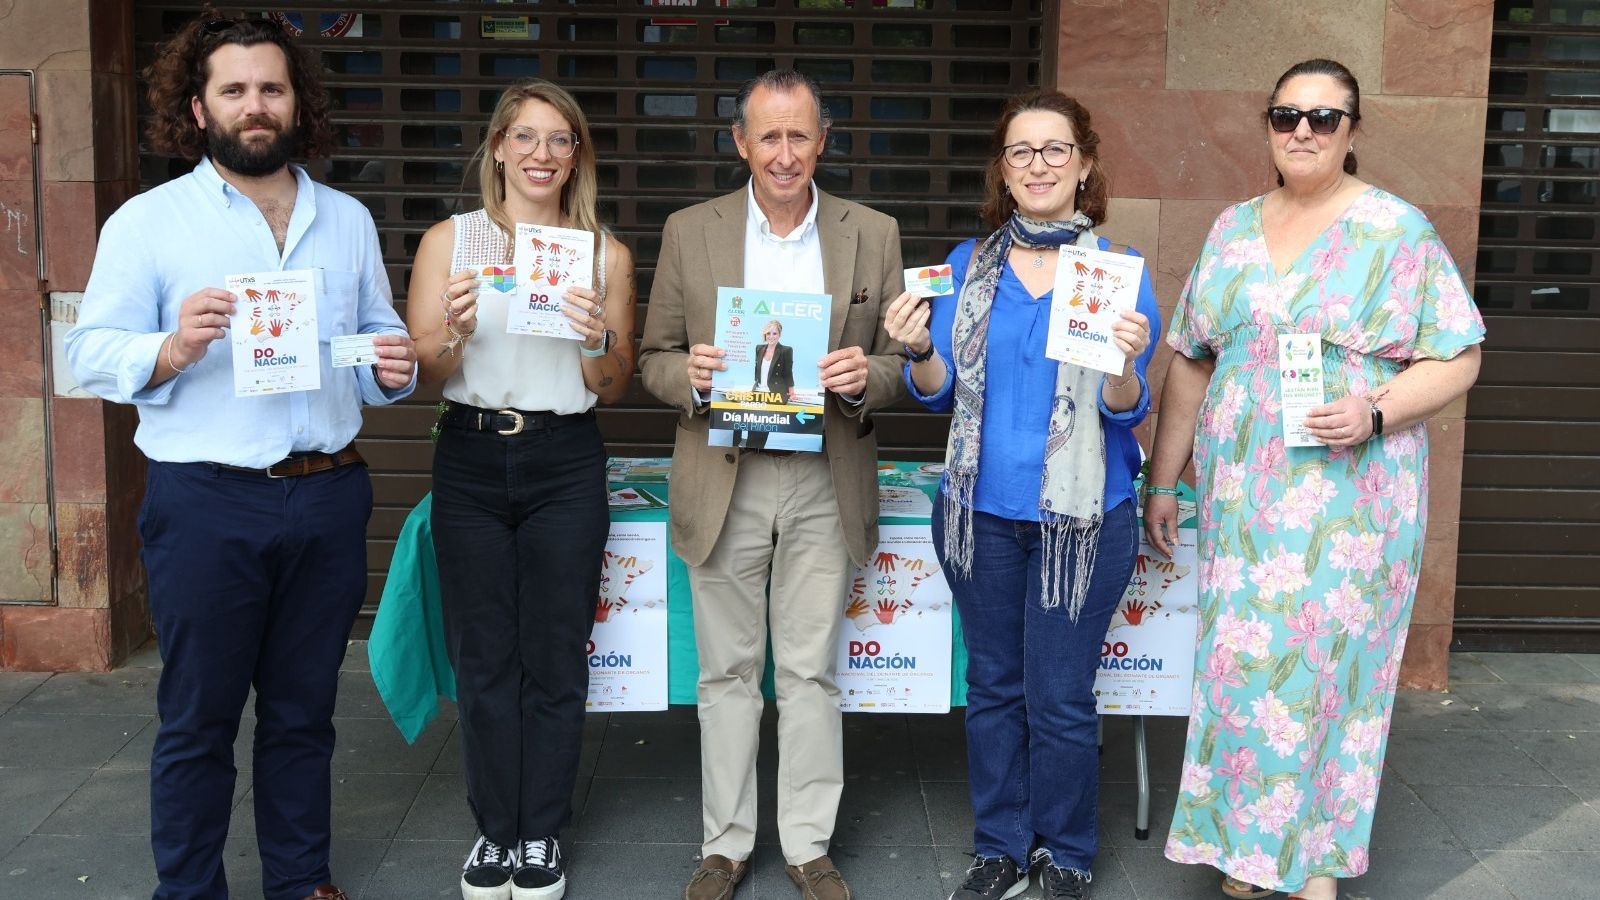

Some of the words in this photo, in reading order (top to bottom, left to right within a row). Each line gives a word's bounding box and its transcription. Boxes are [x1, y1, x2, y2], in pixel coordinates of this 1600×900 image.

[530, 293, 549, 303] DO
[529, 302, 561, 312] NACIÓ
[754, 300, 823, 321] ALCER
[1069, 319, 1088, 331] DO
[1068, 328, 1108, 344] NACIÓN
[254, 347, 274, 359] DO
[254, 354, 297, 367] NACIÓN
[725, 391, 783, 403] CRISTINA
[722, 411, 741, 422] Día
[743, 413, 791, 425] Mundial
[586, 640, 596, 655] O
[849, 641, 881, 656] DO
[1101, 642, 1129, 657] DO
[589, 650, 632, 667] CIÓN
[849, 653, 916, 669] NACIÓN
[1100, 654, 1163, 671] NACIÓN
